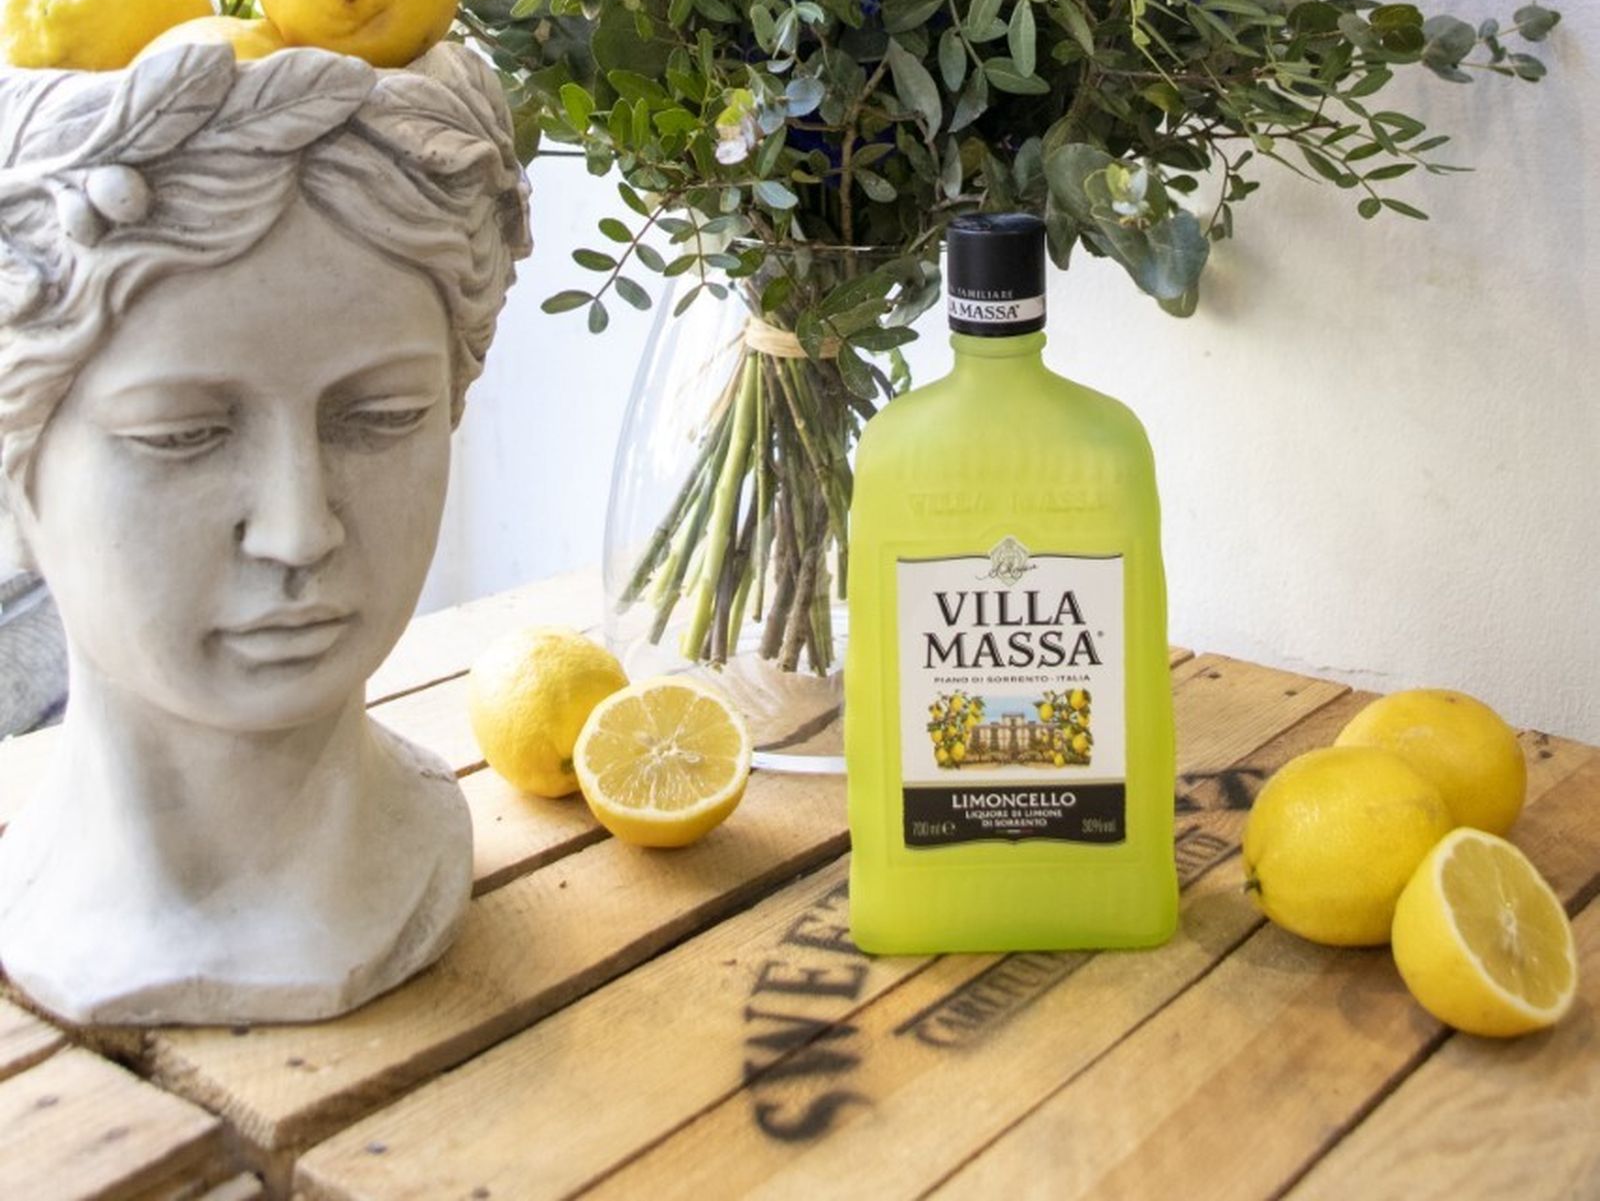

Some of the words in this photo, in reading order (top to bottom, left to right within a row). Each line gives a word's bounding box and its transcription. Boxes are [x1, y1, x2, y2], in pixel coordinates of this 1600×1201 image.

[960, 302, 1018, 320] MASSA
[933, 590, 1086, 627] VILLA
[922, 630, 1103, 669] MASSA
[934, 676, 969, 684] PIANO
[987, 675, 1048, 684] SORRENTO
[1056, 674, 1091, 683] ITALIA
[952, 792, 1076, 809] LIMONCELLO
